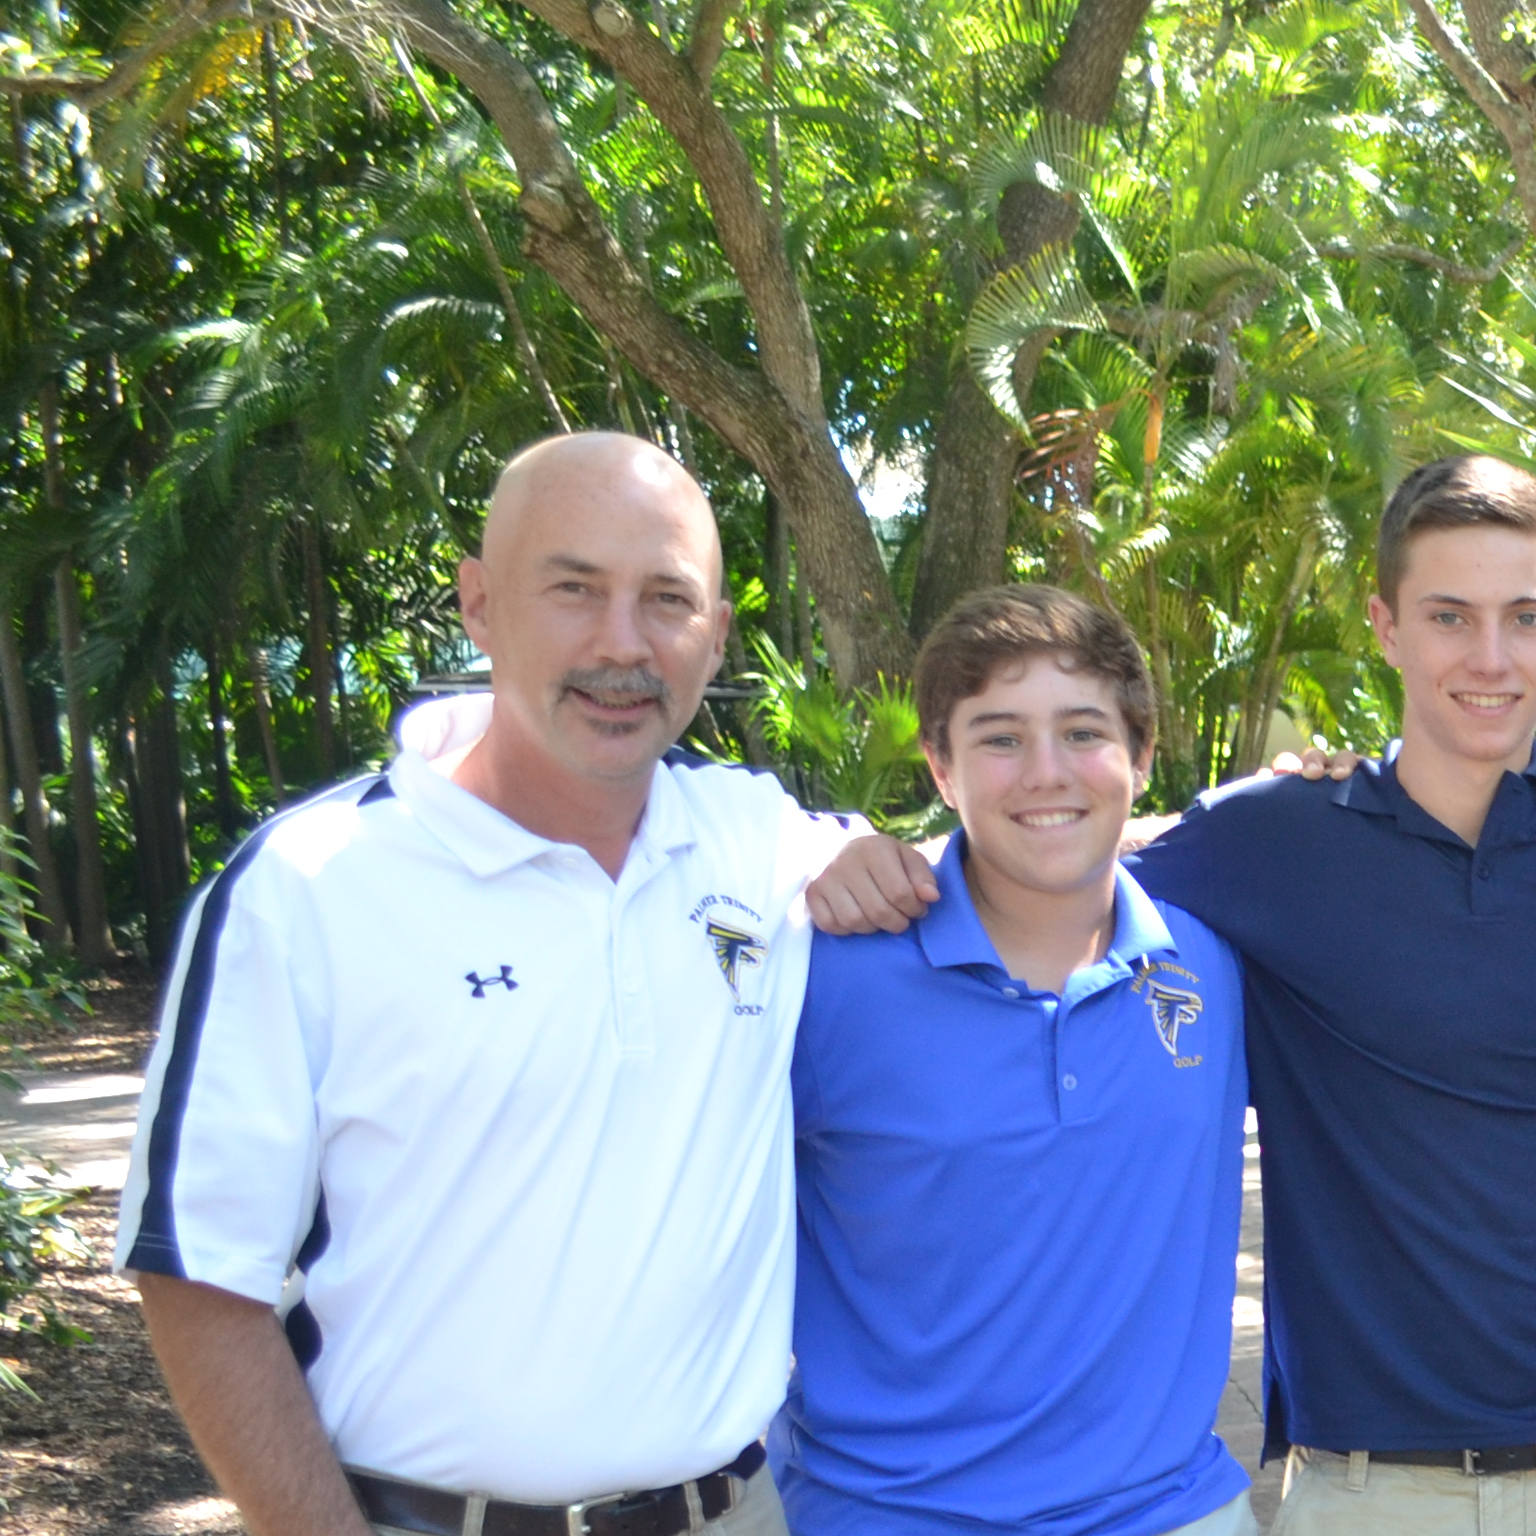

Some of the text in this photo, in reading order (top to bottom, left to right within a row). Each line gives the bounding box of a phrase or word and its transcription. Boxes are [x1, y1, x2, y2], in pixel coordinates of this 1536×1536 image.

[688, 894, 764, 924] PALMER TRINITY
[733, 1005, 764, 1017] GOLF
[1173, 1054, 1203, 1069] GOLF
